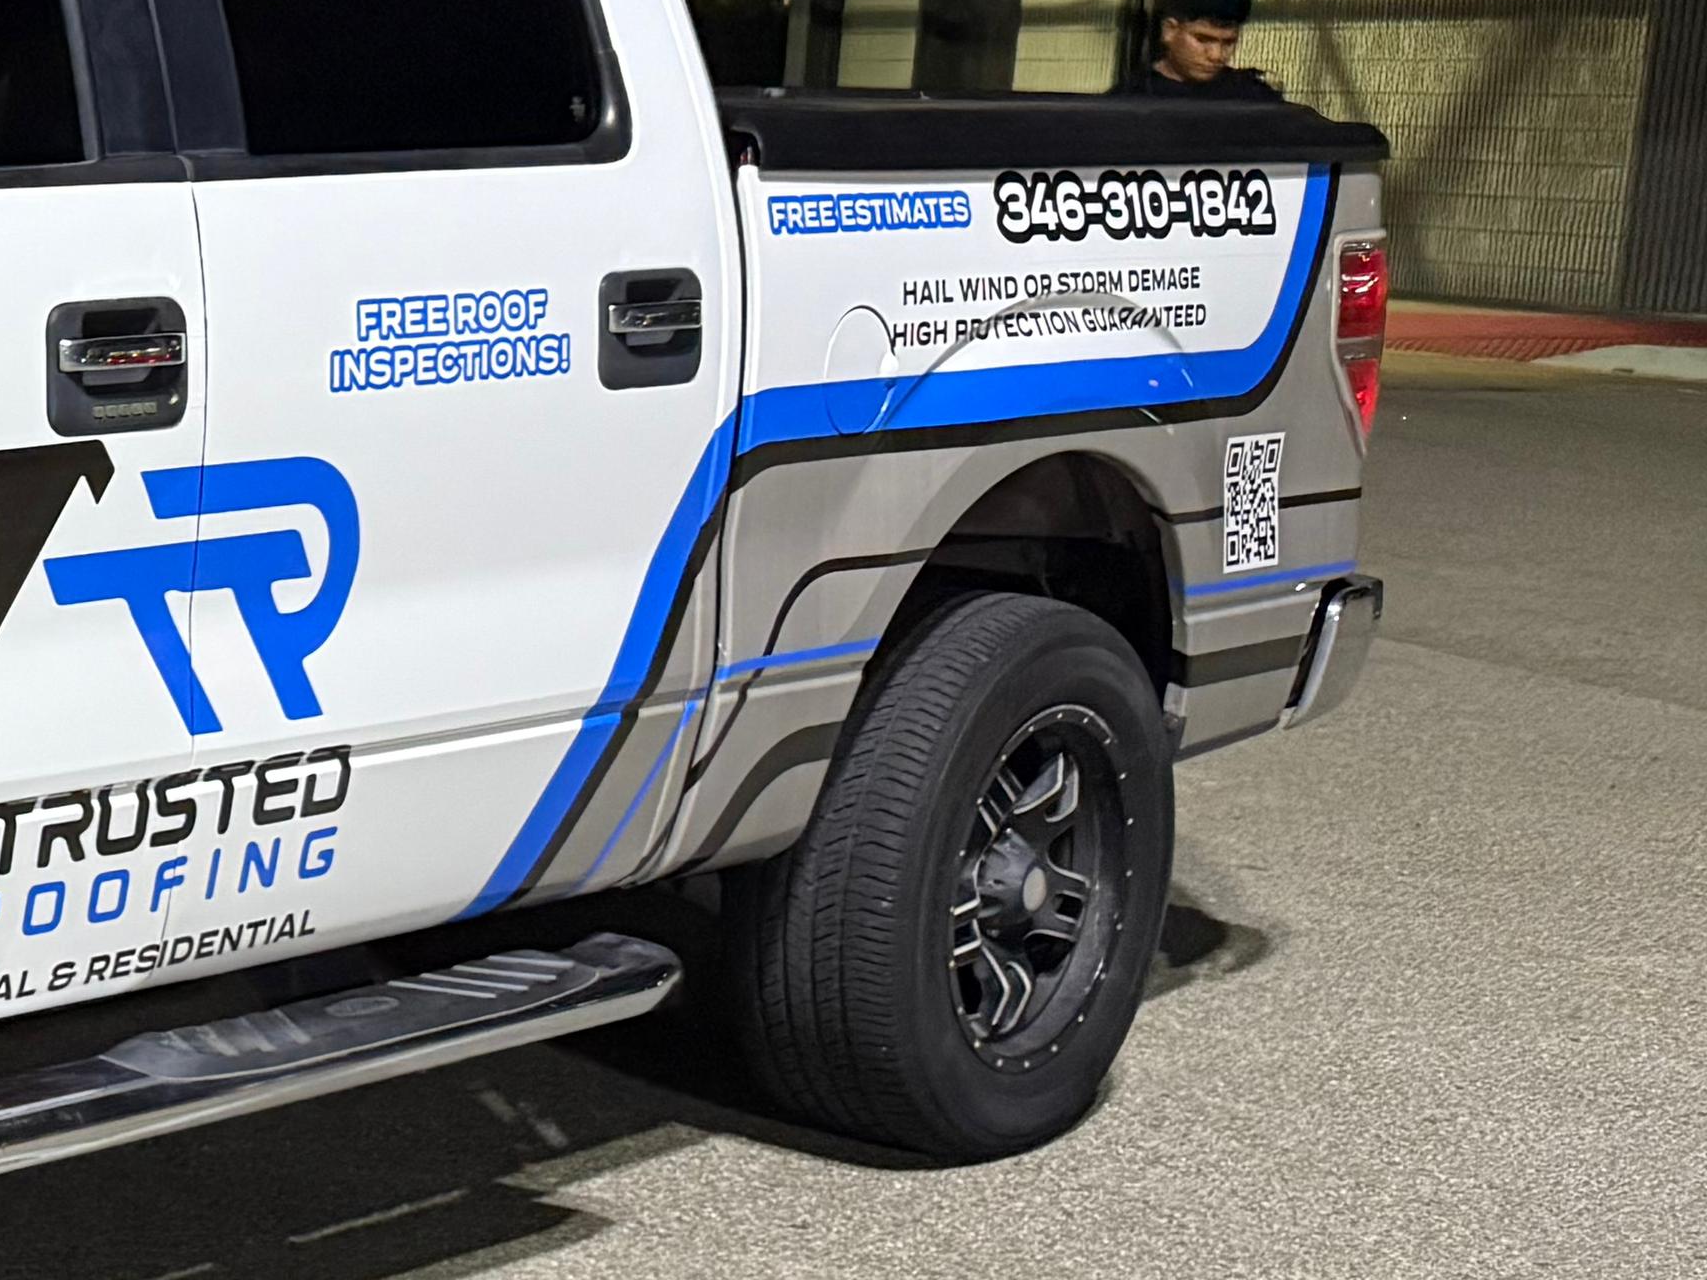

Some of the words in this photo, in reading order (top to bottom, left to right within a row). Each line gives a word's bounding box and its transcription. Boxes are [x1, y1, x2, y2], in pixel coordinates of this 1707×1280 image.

[769, 195, 838, 233] FREE
[837, 191, 971, 231] ESTIMATES
[995, 170, 1276, 242] 346-310-1842
[902, 279, 954, 306] HAIL
[959, 275, 1018, 303] WIND
[1023, 274, 1052, 299] OR
[1057, 269, 1124, 294] STORM
[1128, 266, 1201, 292] DEMAGE
[357, 295, 449, 341] FREE
[454, 288, 547, 334] ROOF
[892, 320, 948, 348] HIGH
[955, 309, 1082, 345] PROTECTION
[1082, 303, 1207, 333] GUARANTEED
[330, 333, 570, 392] INSPECTIONS!
[47, 960, 77, 992] &
[84, 909, 317, 987] RESIDENTIAL
